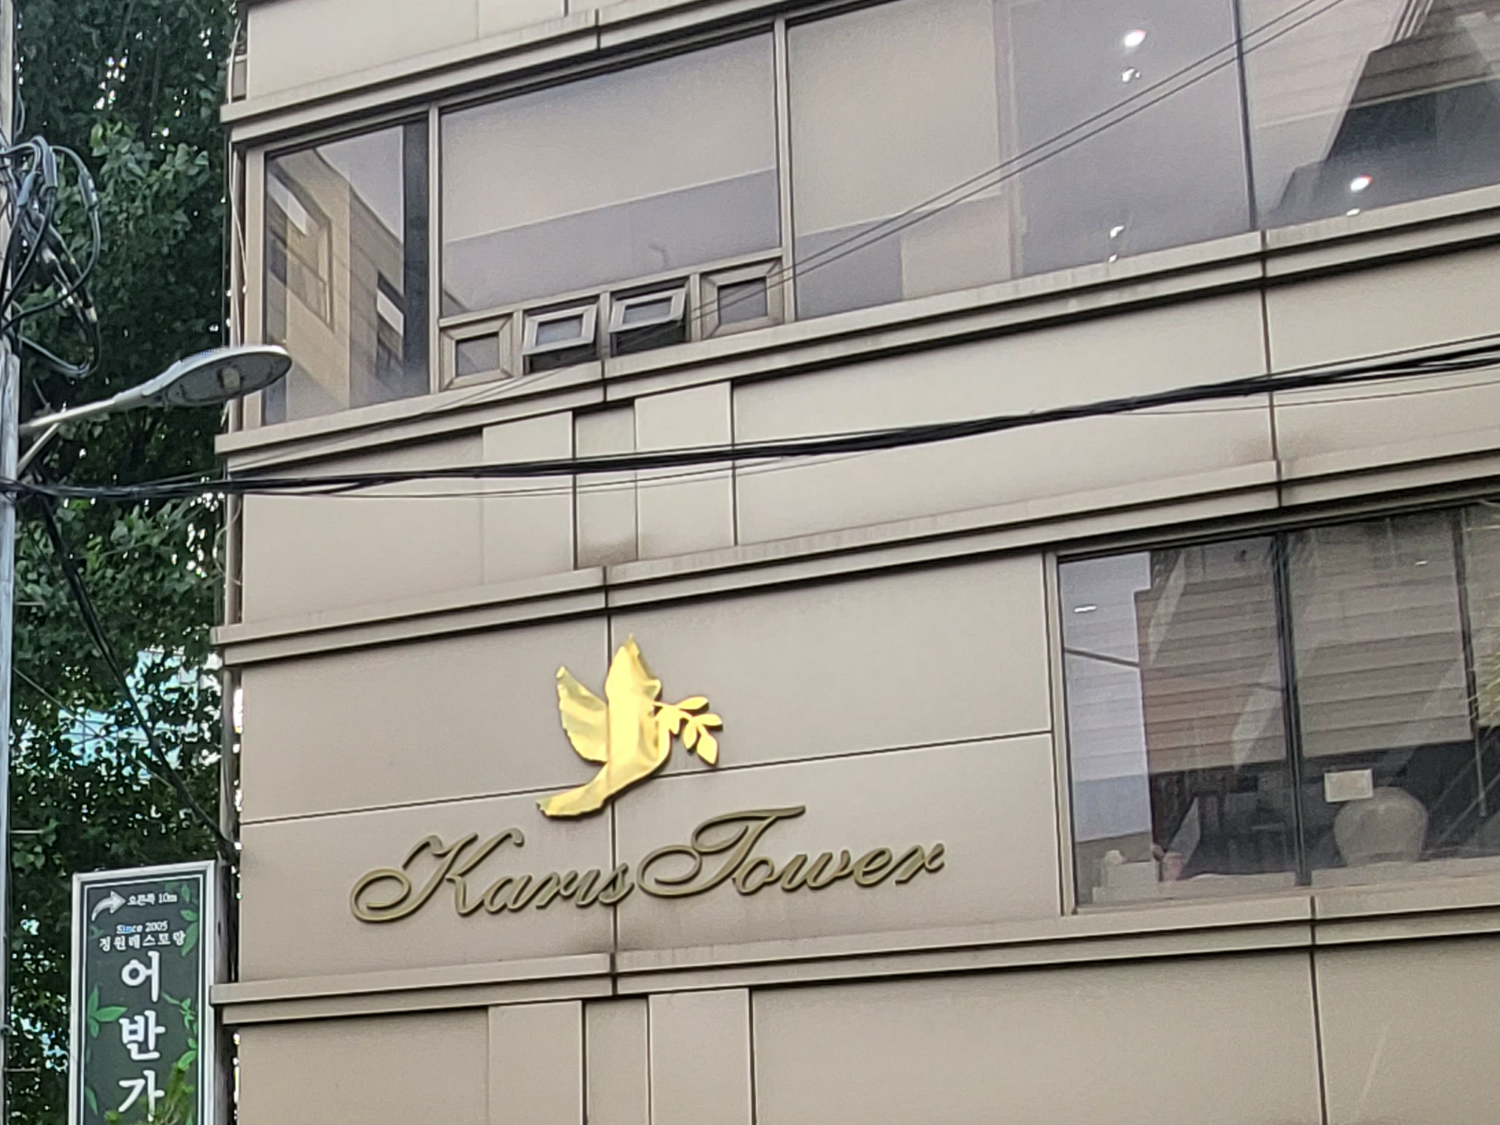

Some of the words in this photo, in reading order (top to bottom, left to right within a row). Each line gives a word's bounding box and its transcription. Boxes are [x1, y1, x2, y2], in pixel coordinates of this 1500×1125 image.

[348, 825, 635, 924] Karis
[636, 804, 947, 898] Tower
[115, 924, 143, 935] Since
